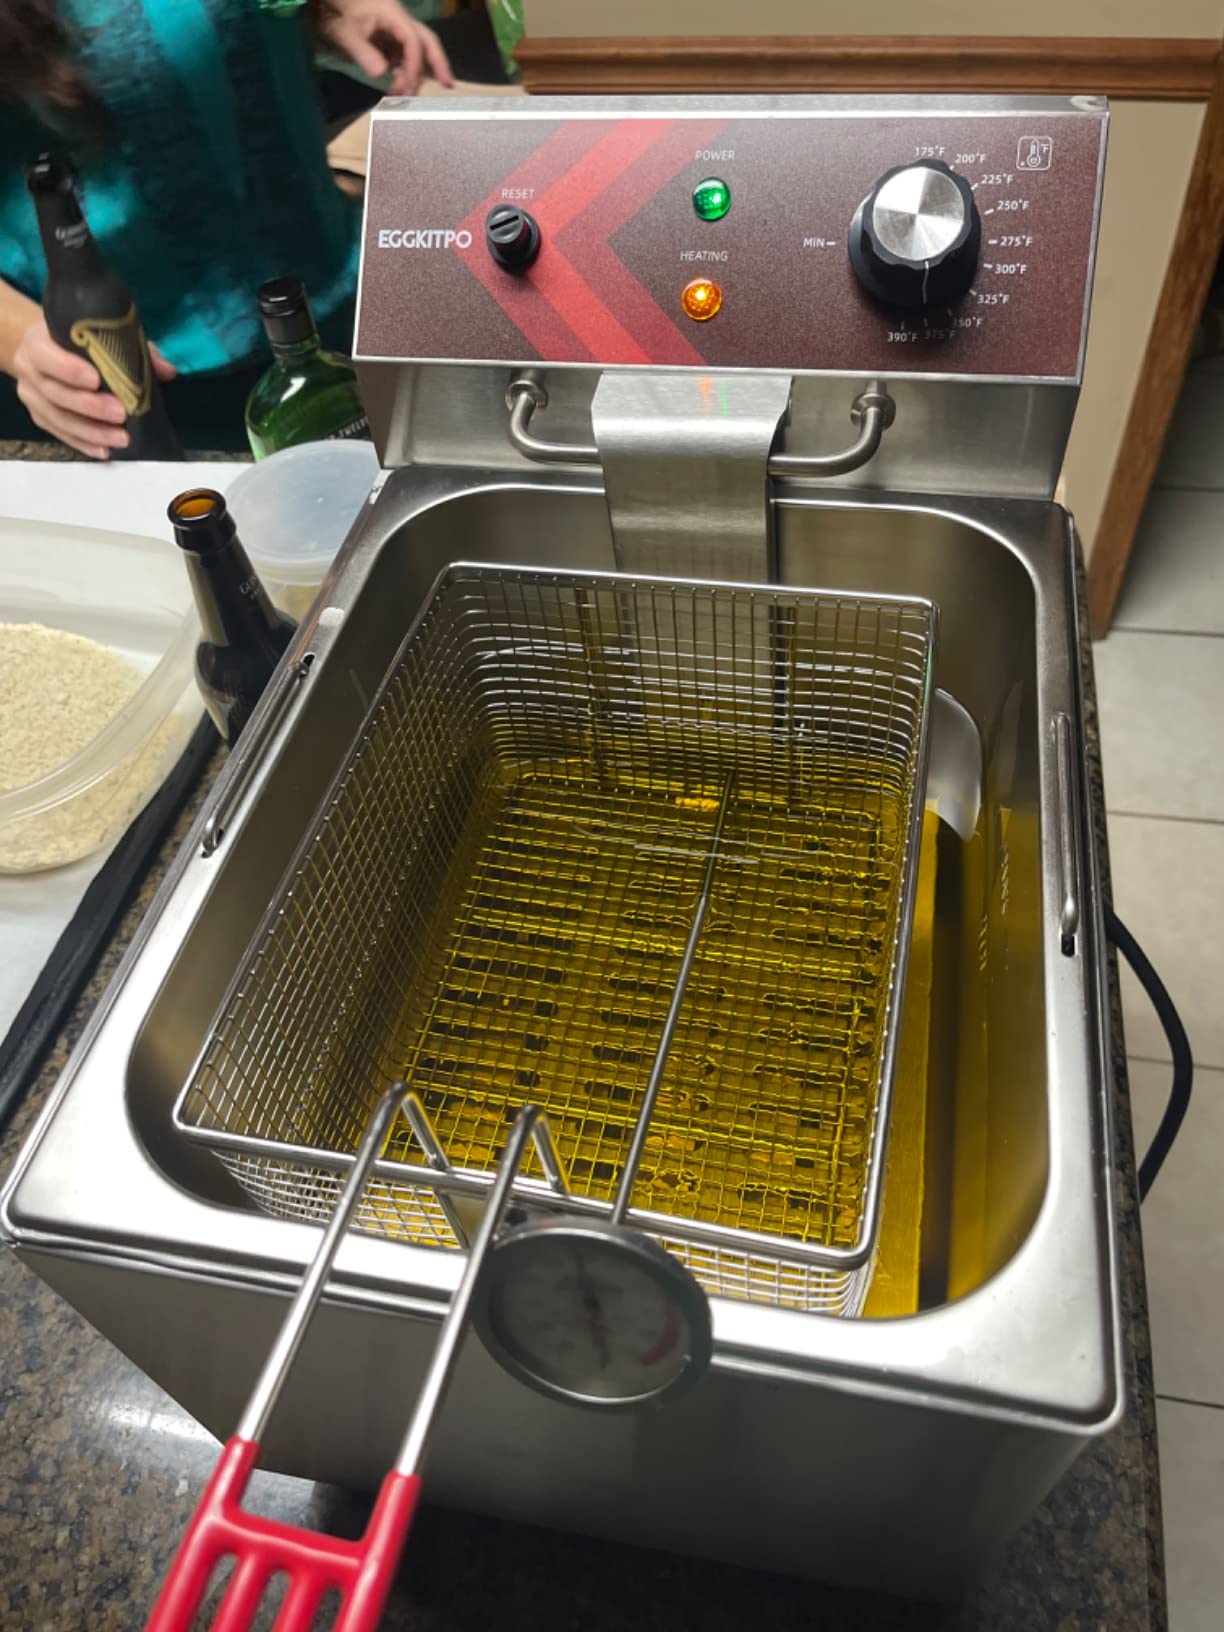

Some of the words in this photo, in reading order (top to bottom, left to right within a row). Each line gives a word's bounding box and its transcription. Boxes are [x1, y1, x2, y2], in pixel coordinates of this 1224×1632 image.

[695, 150, 736, 161] POWER
[915, 145, 946, 157] 175°F
[955, 153, 987, 164] 200°F
[981, 173, 1014, 185] 225°F
[501, 189, 535, 200] RESET
[997, 199, 1030, 211] 250°F
[378, 229, 473, 249] EGGKITPO
[803, 238, 825, 248] MIN
[1000, 235, 1033, 248] 275°F
[679, 251, 729, 262] HEATING
[994, 263, 1028, 275] 300°F
[976, 293, 1010, 305] 325°F
[887, 331, 919, 343] 390°F
